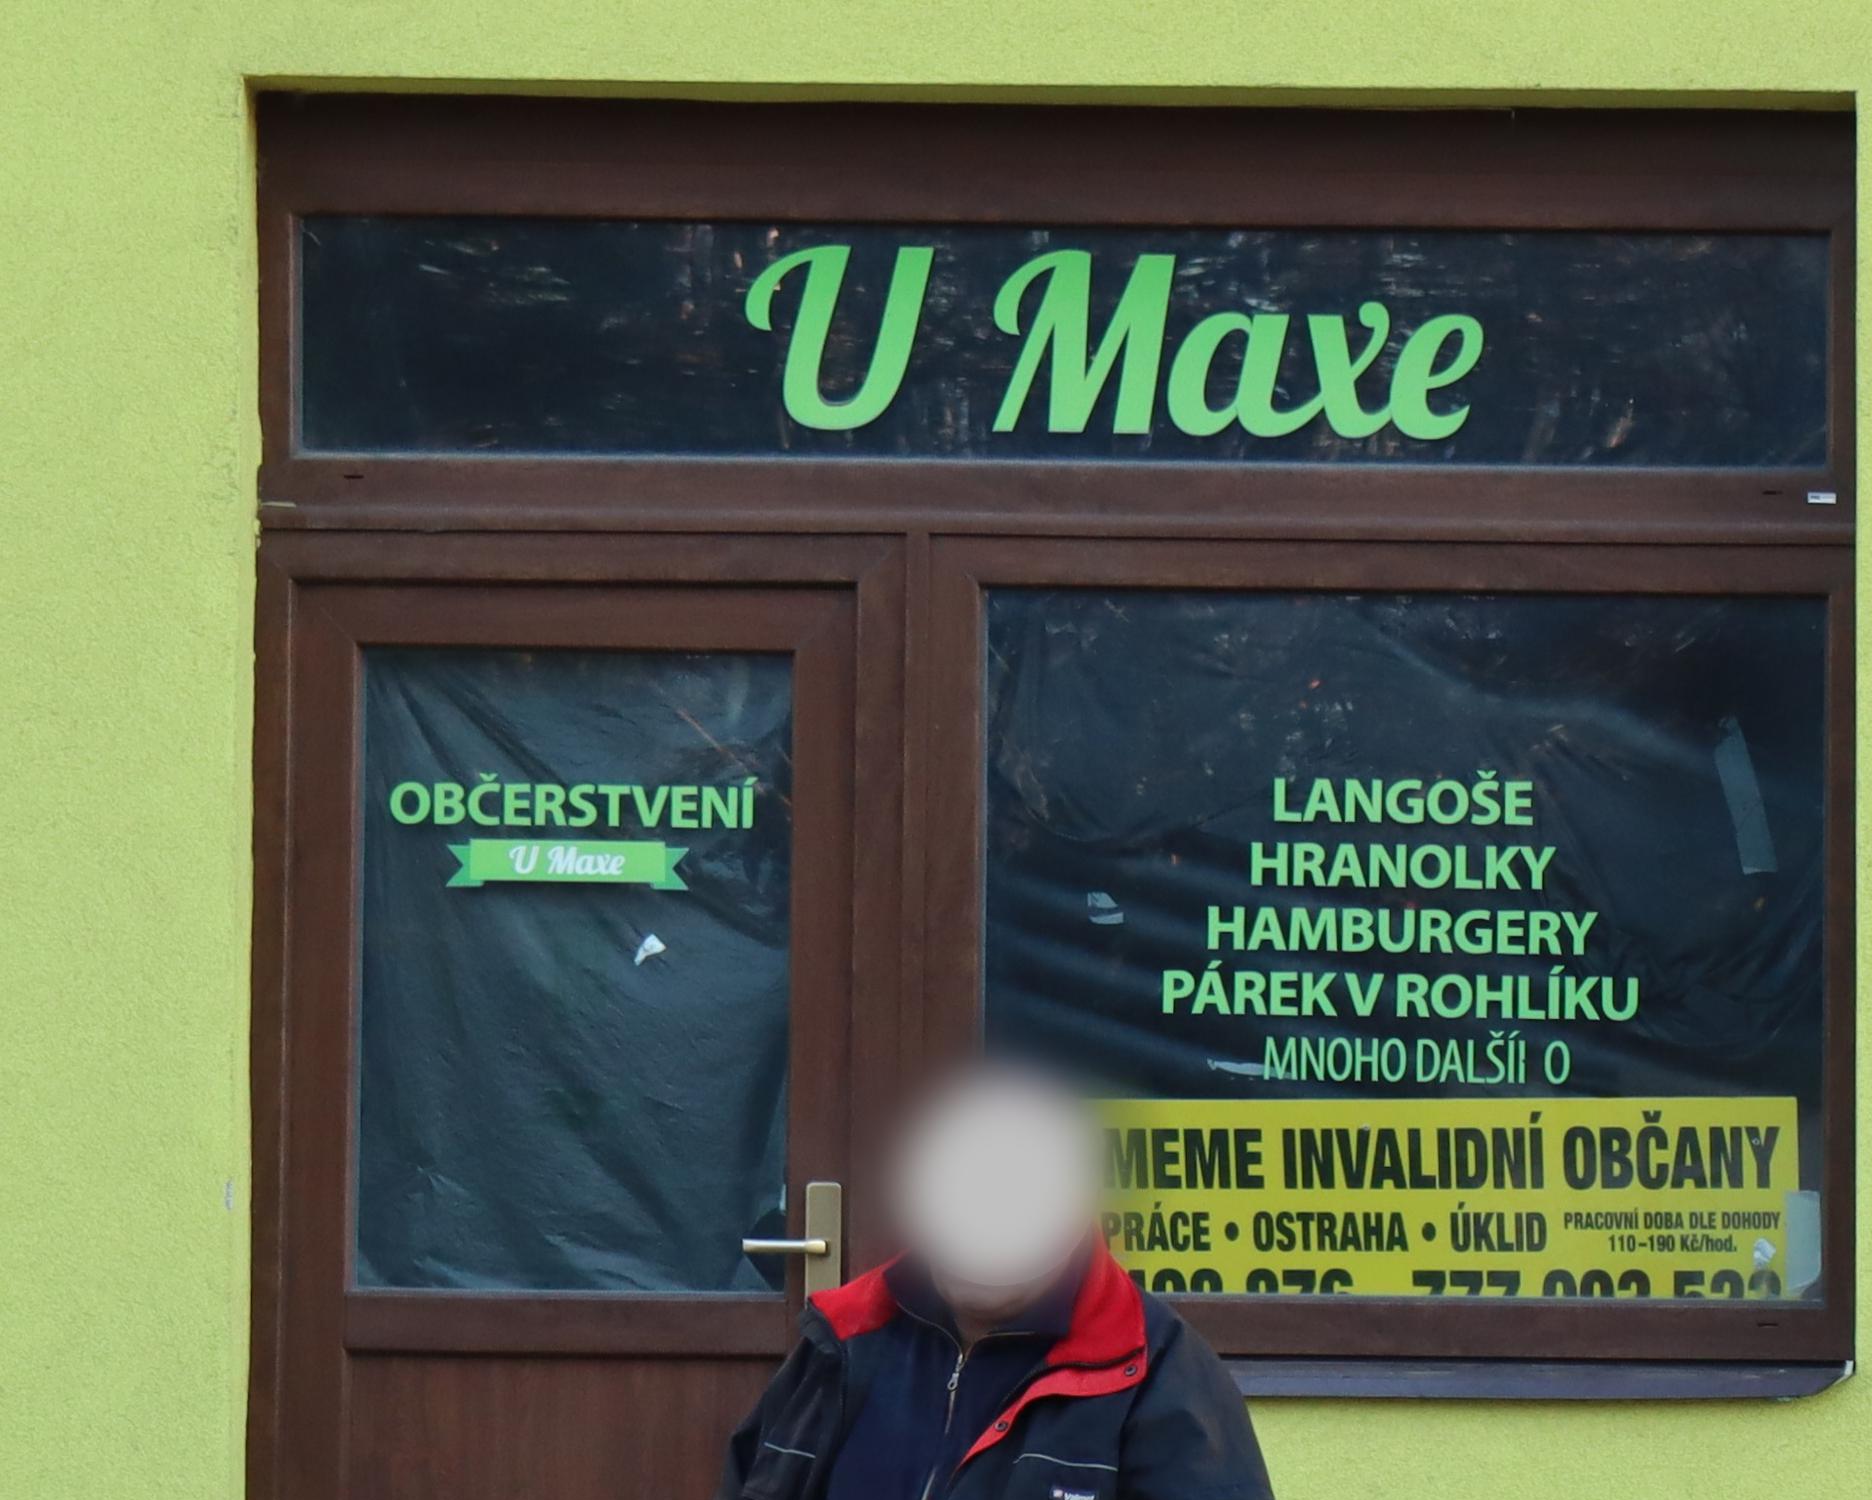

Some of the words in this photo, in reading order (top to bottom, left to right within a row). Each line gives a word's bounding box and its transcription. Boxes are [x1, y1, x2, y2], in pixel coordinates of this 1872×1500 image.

[744, 244, 934, 432] U
[991, 249, 1485, 442] Maxe
[389, 772, 759, 829] OBČERSTVENÍ
[1273, 769, 1533, 826] LANGOŠE
[508, 845, 540, 875] U
[547, 846, 626, 876] Maxe
[1250, 841, 1556, 890] HRANOLKY
[1207, 905, 1598, 956] HAMBURGERY
[1162, 961, 1337, 1017] PÁREK
[1342, 972, 1384, 1016] V
[1396, 965, 1639, 1021] ROHLÍKU
[1261, 1036, 1407, 1082] MNOHO
[1282, 1111, 1544, 1190] INVALIDNÍ
[1562, 1110, 1780, 1190] OBČANY
[1102, 1201, 1211, 1252] PRÁCE
[1252, 1211, 1409, 1252] OSTRAHA
[1450, 1201, 1547, 1253] ÚKLID
[1563, 1207, 1639, 1230] PRACOVNÍ
[1643, 1211, 1684, 1230] DOBA
[1689, 1211, 1717, 1230] DLE
[1721, 1211, 1781, 1230] DOHODY
[1679, 1233, 1738, 1253] Kč/hod.
